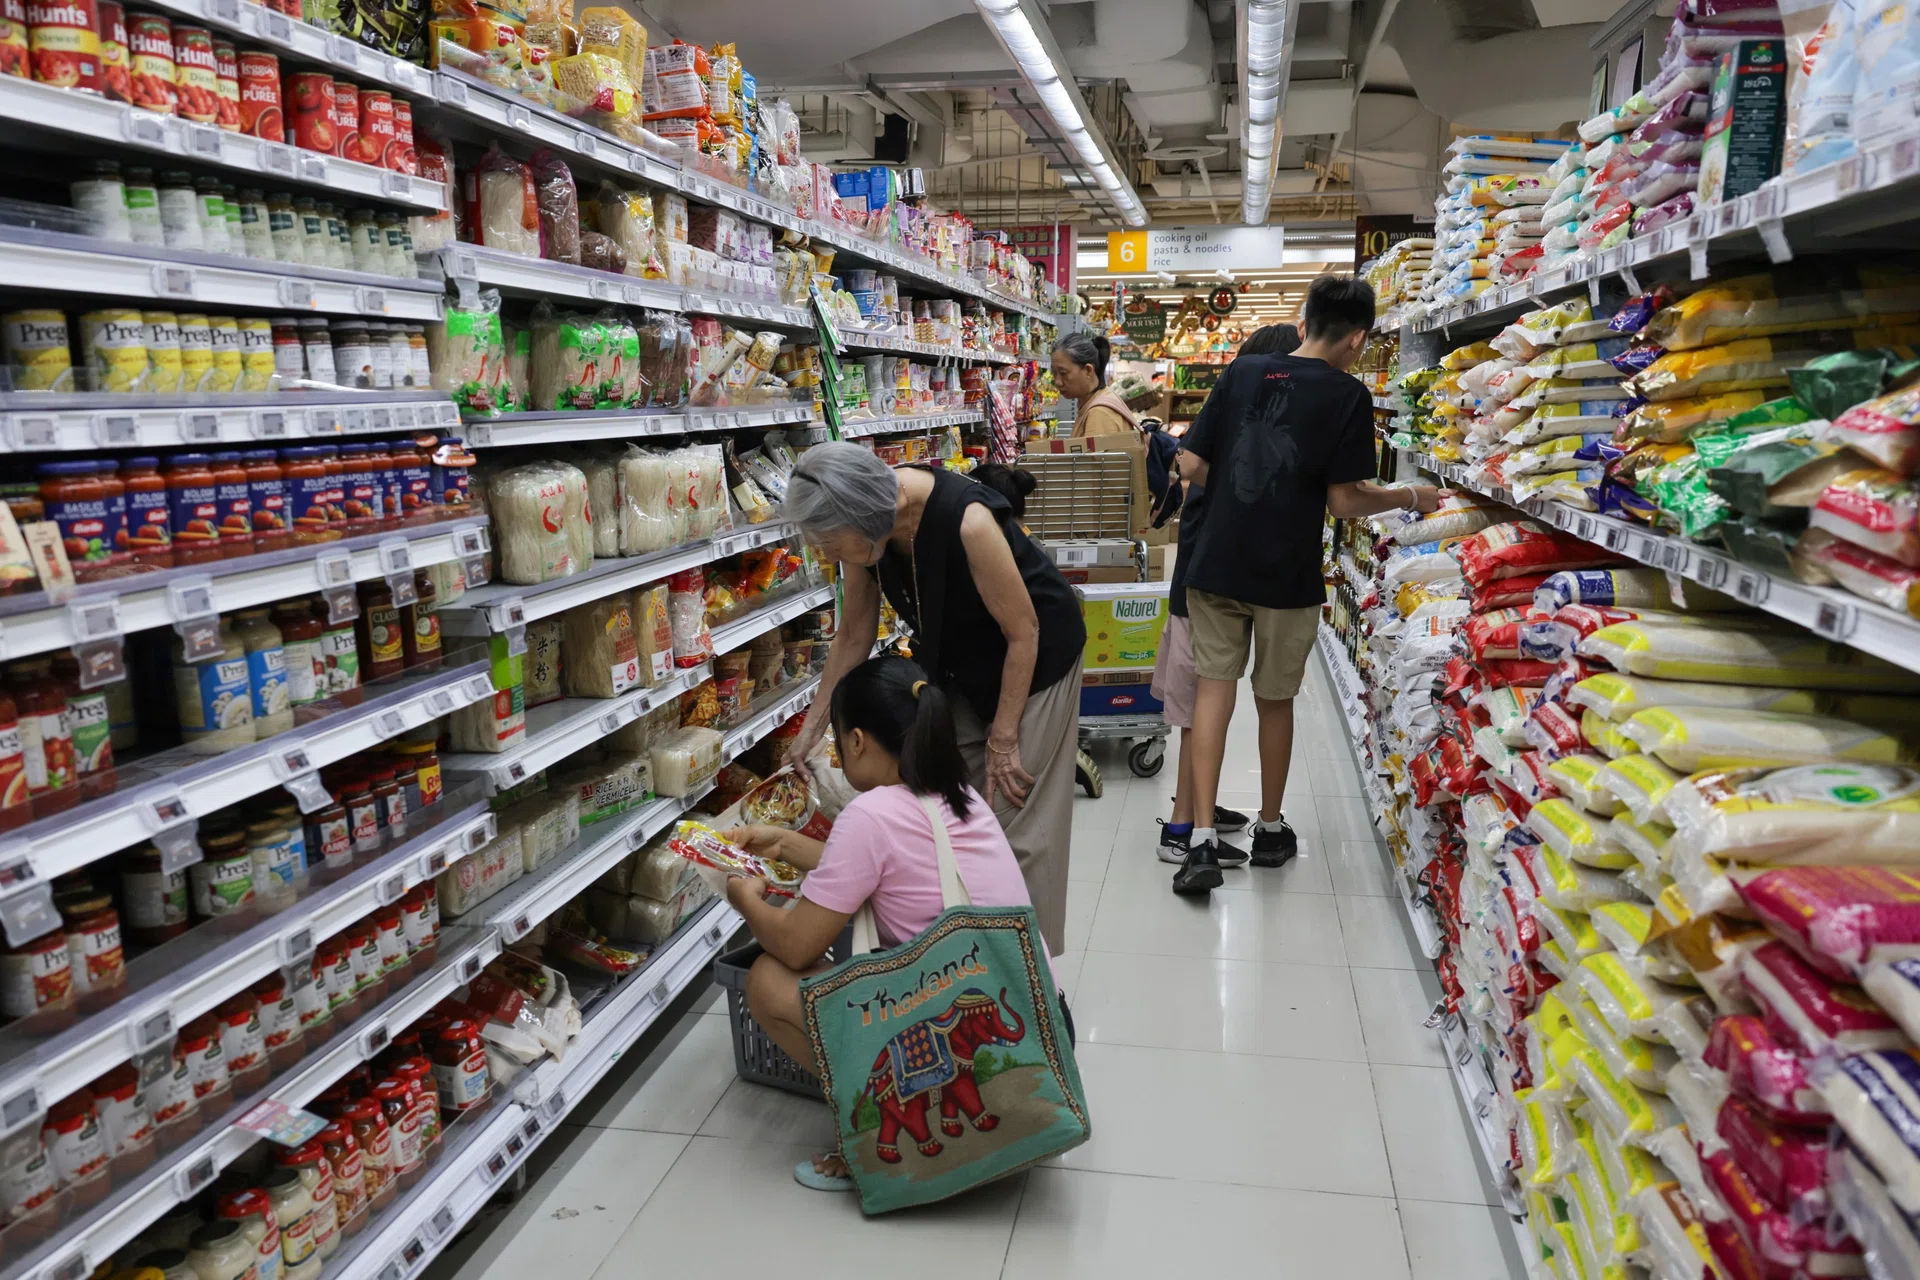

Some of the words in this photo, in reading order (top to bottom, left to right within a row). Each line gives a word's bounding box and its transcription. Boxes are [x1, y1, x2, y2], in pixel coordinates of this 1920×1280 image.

[1154, 233, 1191, 244] cooking
[1195, 232, 1207, 242] oil
[1361, 230, 1389, 256] 10
[1390, 232, 1406, 240] BYD
[1120, 241, 1134, 262] 6
[1154, 246, 1179, 255] pasta
[1184, 245, 1191, 253] &
[1195, 244, 1232, 253] noodles
[1153, 258, 1171, 266] rice
[1116, 598, 1157, 617] Naturel
[1112, 697, 1132, 705] Barilla
[581, 783, 594, 797] A1
[595, 781, 613, 795] RICE
[595, 784, 639, 805] VERMICELLI
[847, 940, 988, 1026] Thailand
